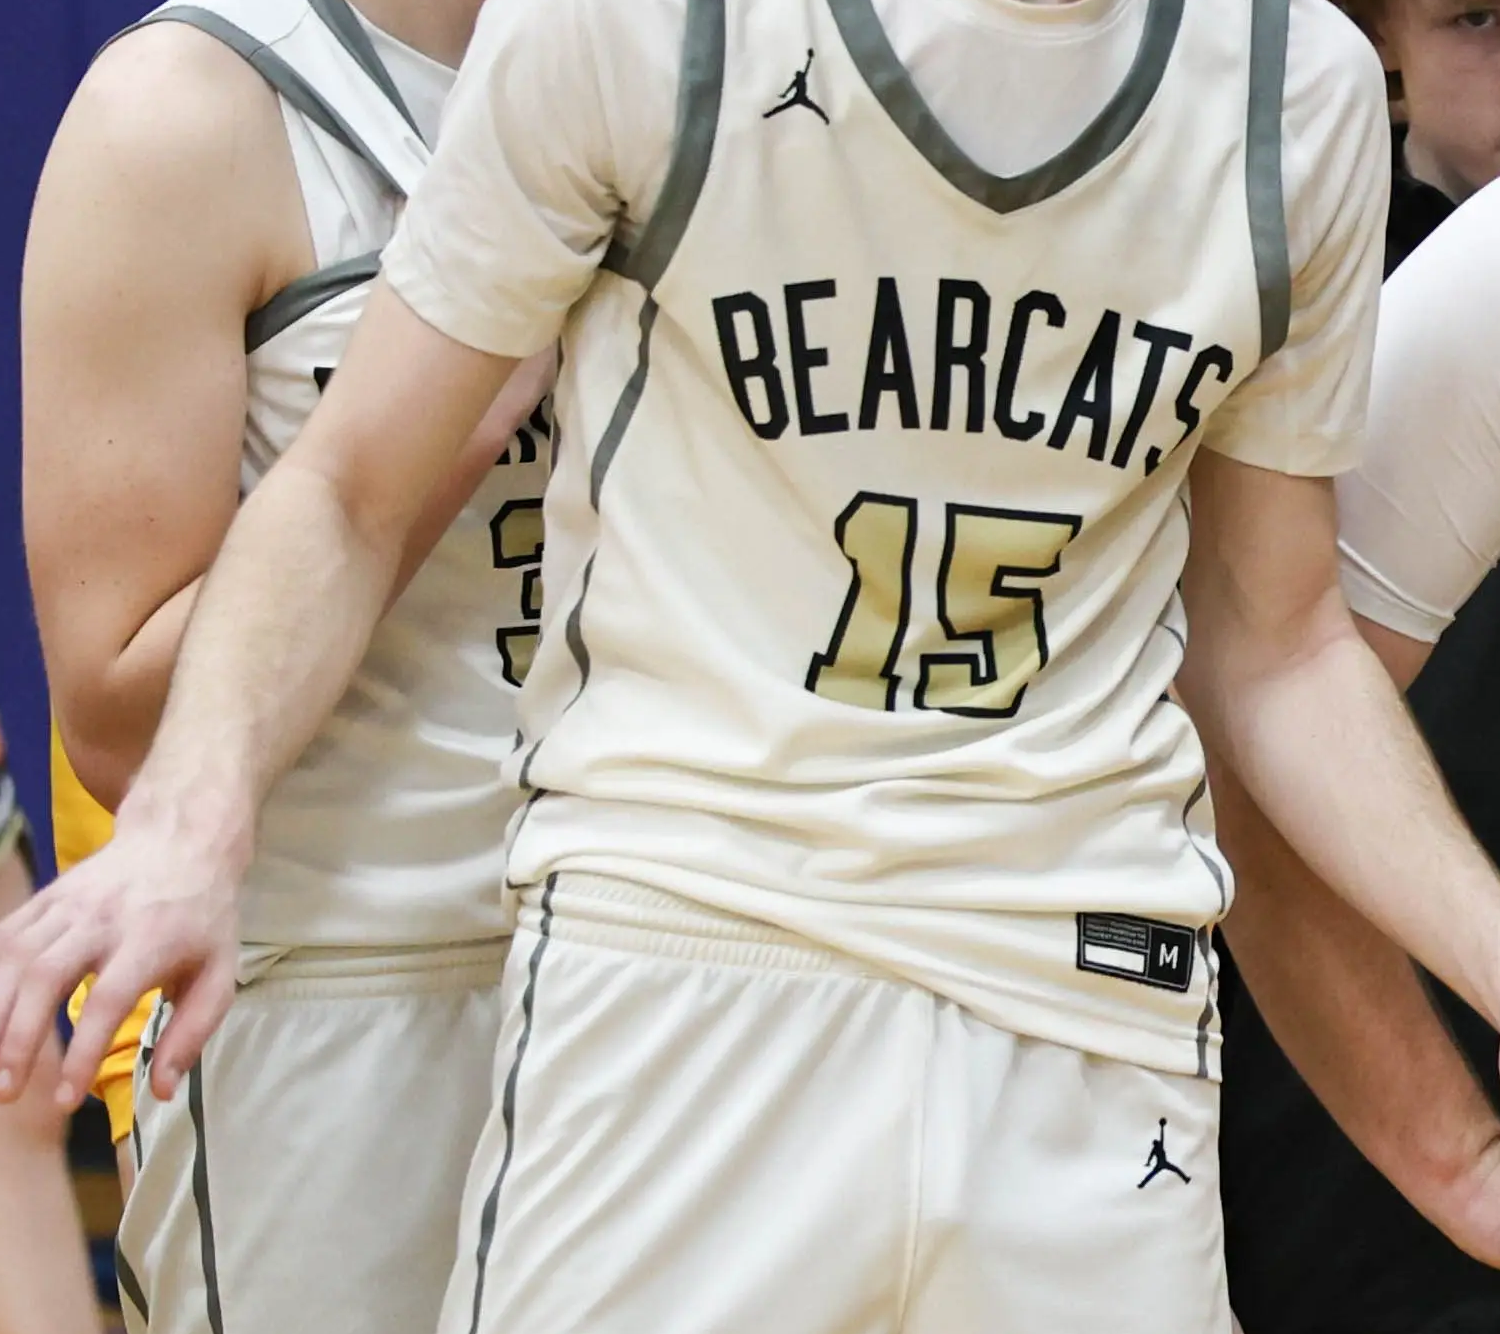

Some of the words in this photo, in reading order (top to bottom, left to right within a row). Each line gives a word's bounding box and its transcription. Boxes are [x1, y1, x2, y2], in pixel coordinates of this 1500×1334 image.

[711, 276, 1234, 476] BEARCATS
[805, 490, 1083, 719] 15
[1159, 942, 1179, 969] M
